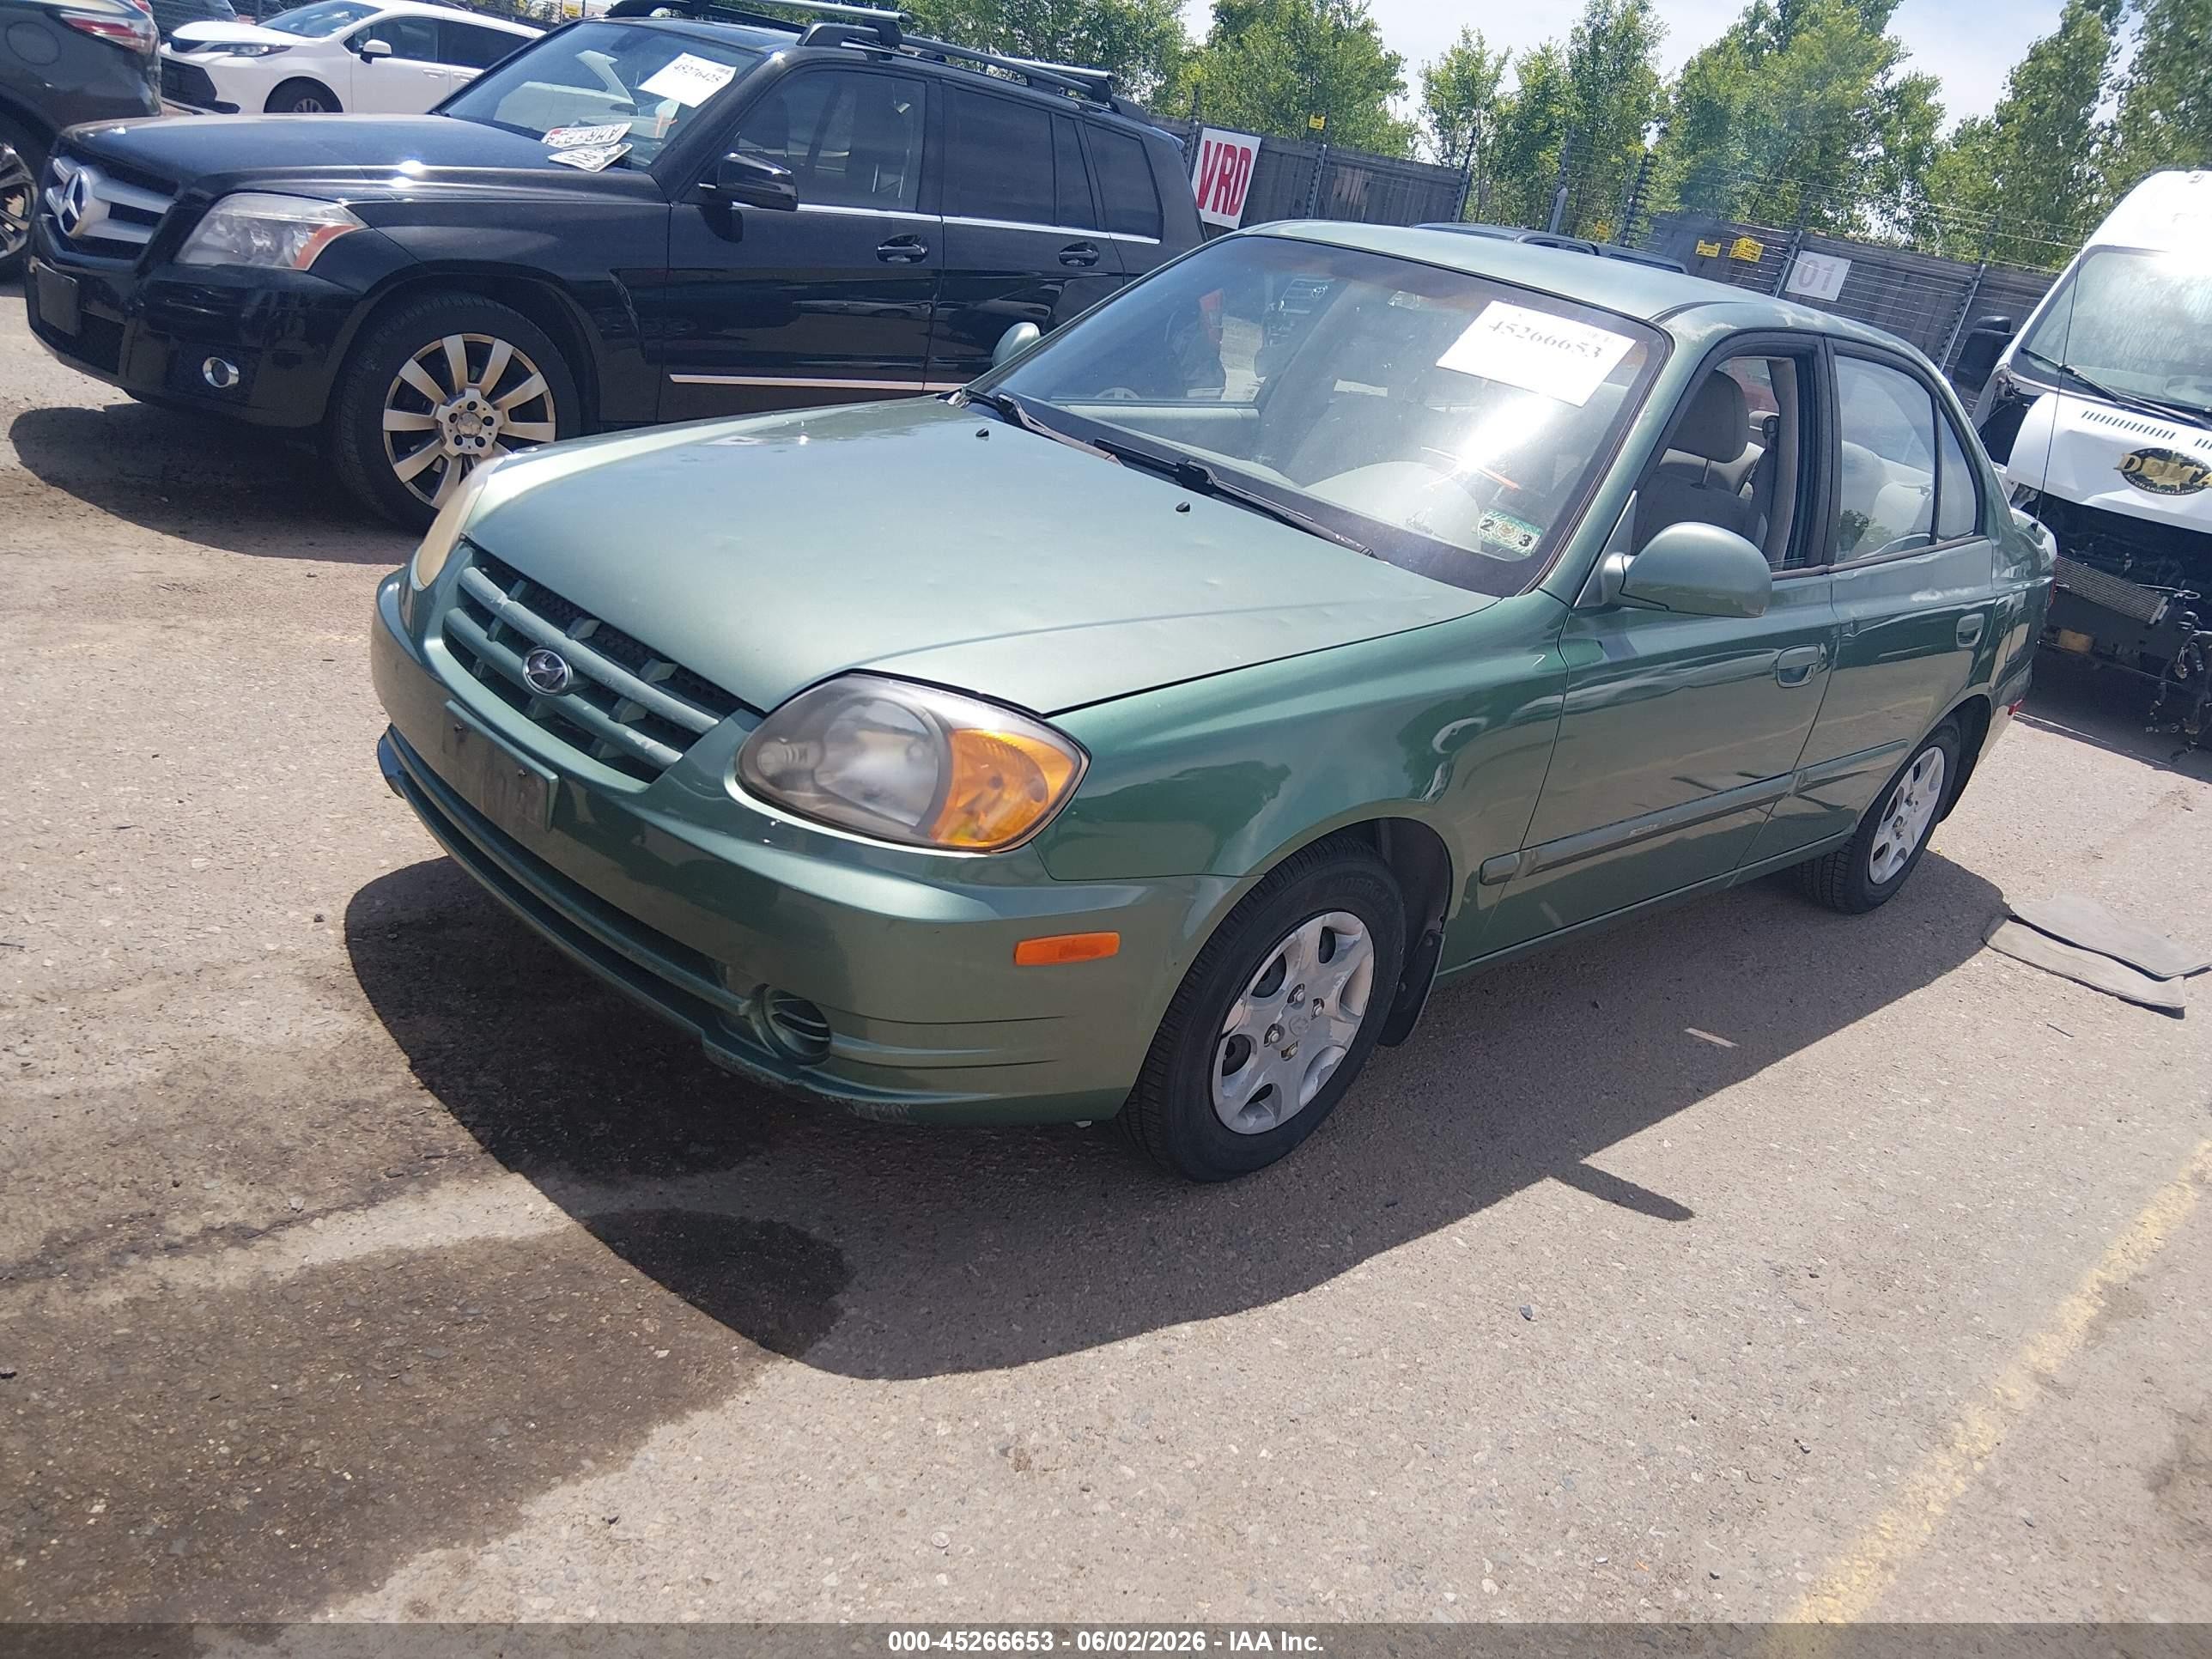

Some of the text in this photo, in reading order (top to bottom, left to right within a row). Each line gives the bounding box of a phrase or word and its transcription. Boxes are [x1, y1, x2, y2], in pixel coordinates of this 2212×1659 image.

[1197, 140, 1252, 216] VRD
[1798, 259, 1836, 291] 01
[1488, 320, 1602, 358] 45266653
[1480, 519, 1533, 547] 2 3
